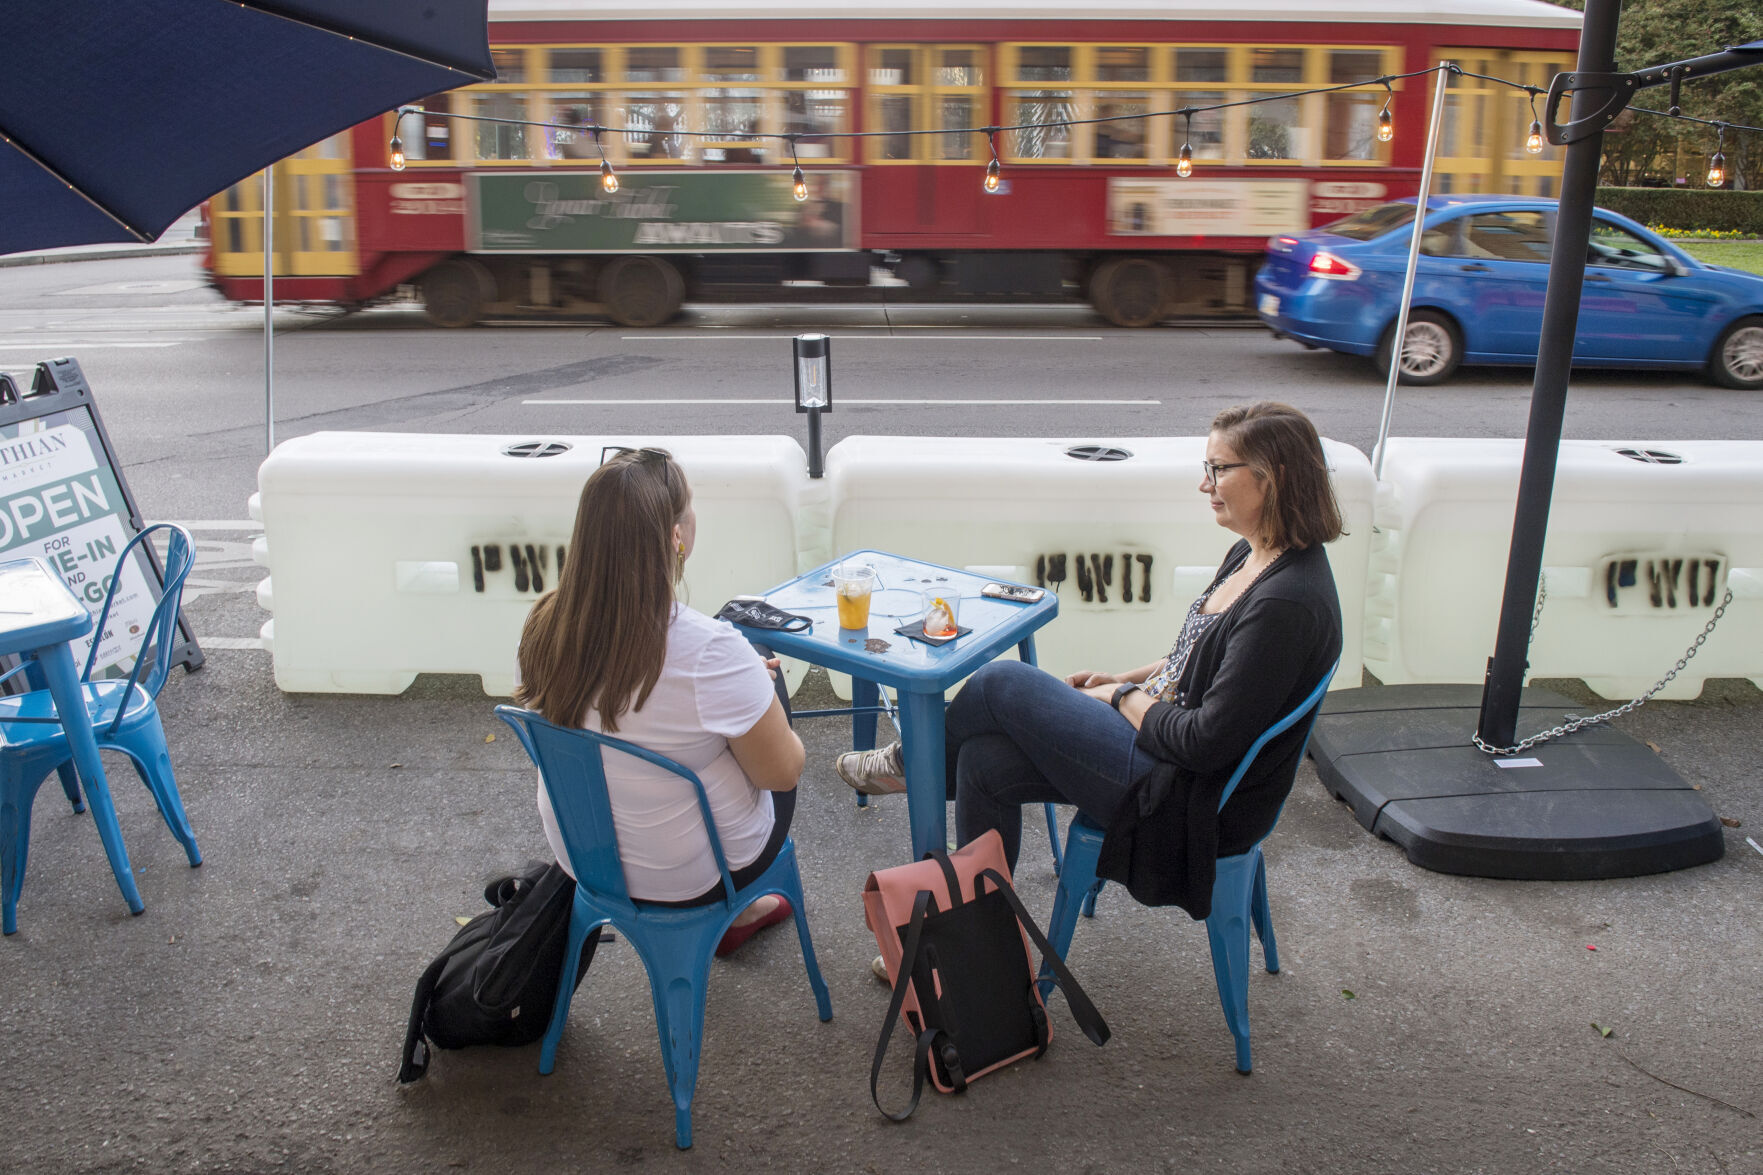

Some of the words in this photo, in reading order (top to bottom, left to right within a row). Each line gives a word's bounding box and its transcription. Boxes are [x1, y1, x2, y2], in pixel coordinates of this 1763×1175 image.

[2, 462, 52, 481] MARKET
[43, 536, 71, 554] FOR
[48, 535, 117, 575] E-IN
[67, 572, 86, 587] ND
